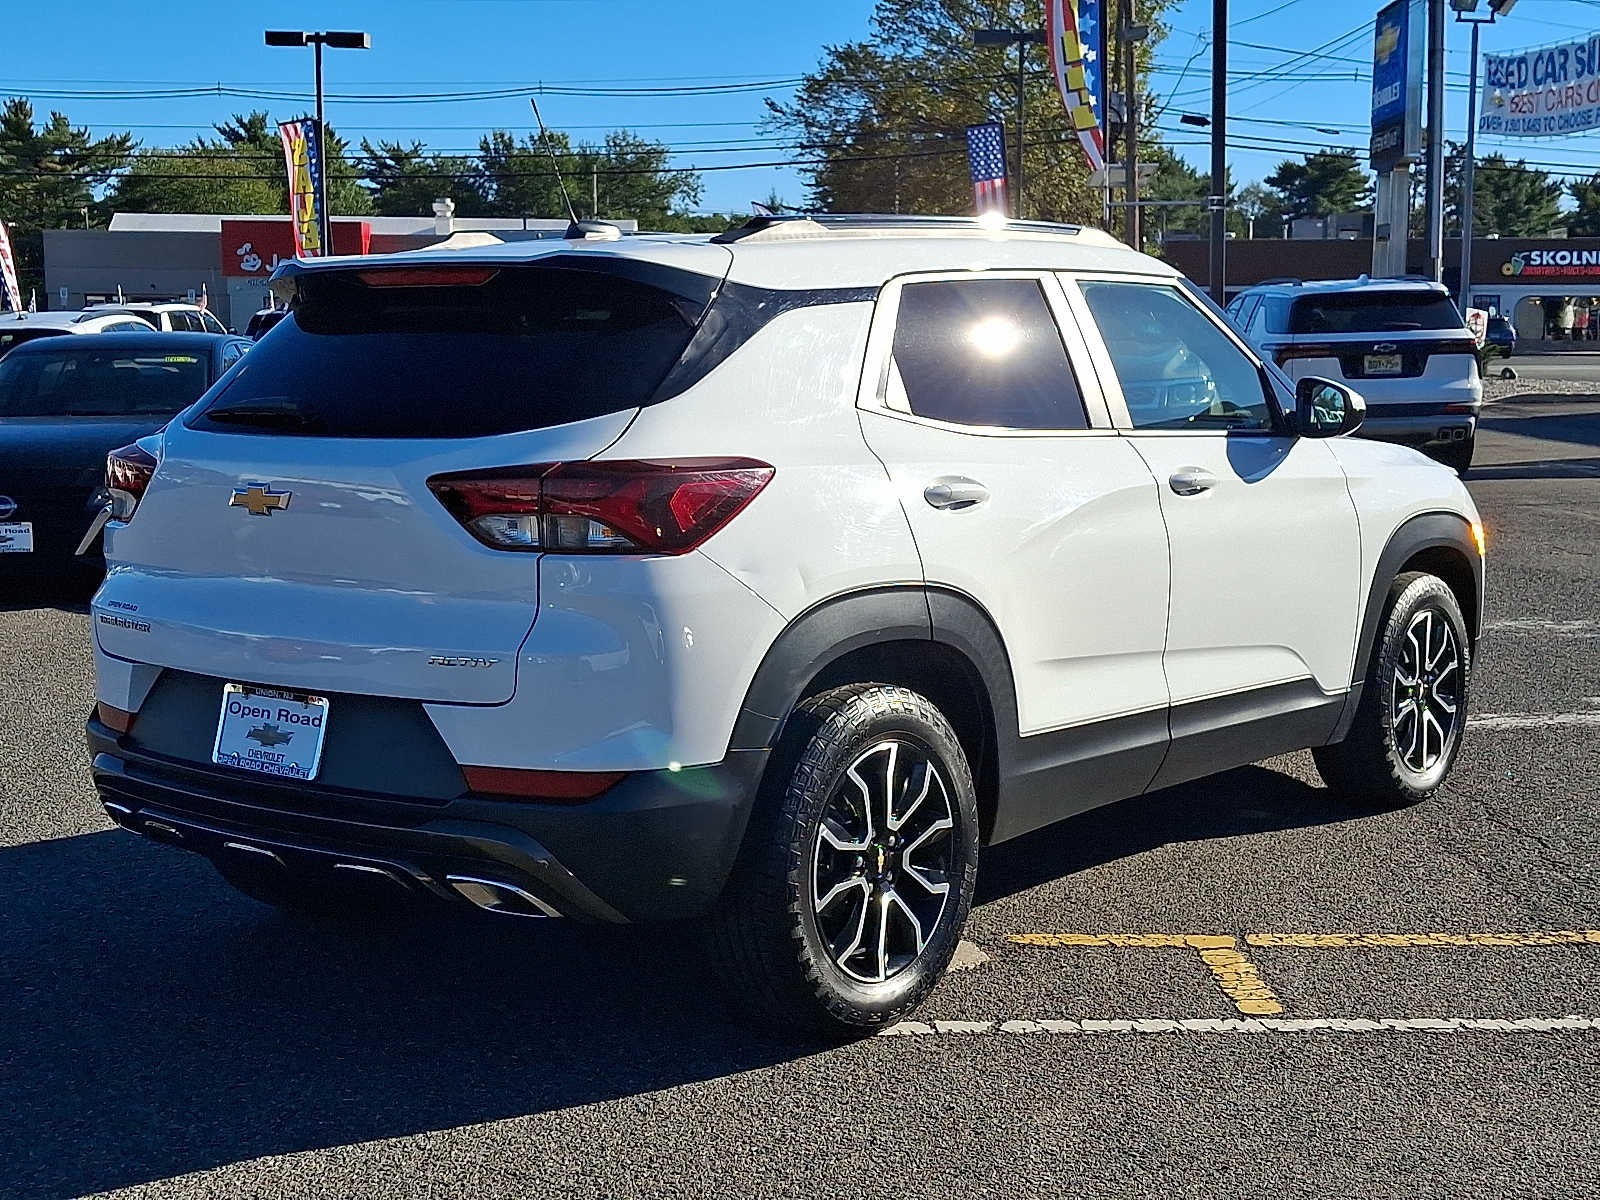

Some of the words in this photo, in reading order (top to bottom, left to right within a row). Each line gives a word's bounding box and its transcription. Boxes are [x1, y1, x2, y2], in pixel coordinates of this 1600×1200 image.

[1533, 47, 1569, 87] CAR
[1575, 35, 1600, 79] SU
[1509, 91, 1543, 114] BEST
[1545, 83, 1583, 112] CARS
[1543, 116, 1556, 131] TO
[1558, 108, 1593, 130] CHOOSE
[229, 701, 271, 720] Open
[277, 708, 322, 728] Road
[218, 754, 239, 766] OPEN
[240, 758, 262, 771] ROAD
[263, 763, 309, 779] CHEVROLET
[248, 748, 286, 763] CHEVROLET
